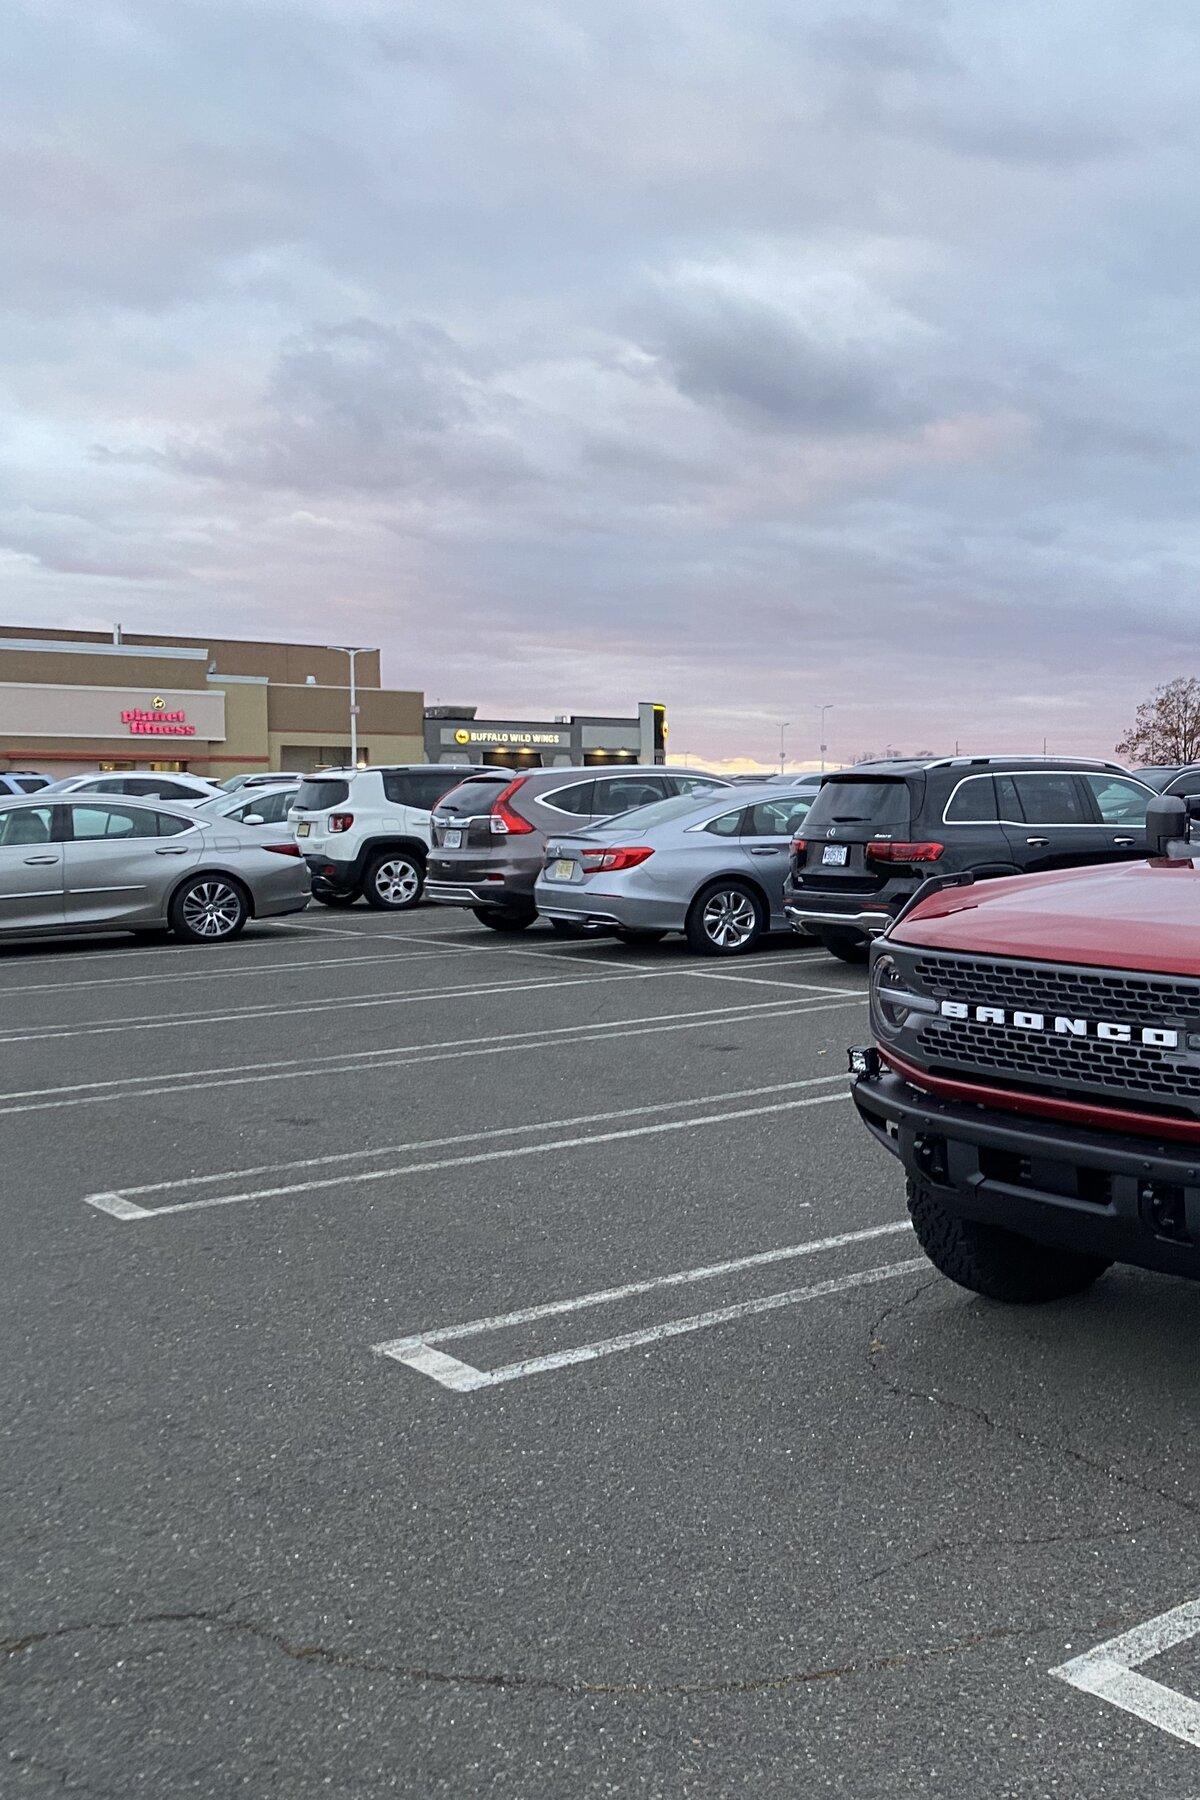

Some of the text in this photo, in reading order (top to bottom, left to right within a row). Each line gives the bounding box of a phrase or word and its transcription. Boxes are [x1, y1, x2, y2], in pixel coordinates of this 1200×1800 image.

[121, 708, 185, 724] planet
[130, 720, 196, 736] fitness
[470, 732, 560, 744] BUFFALO WILD WINGS
[941, 1000, 1178, 1048] BRONCO
